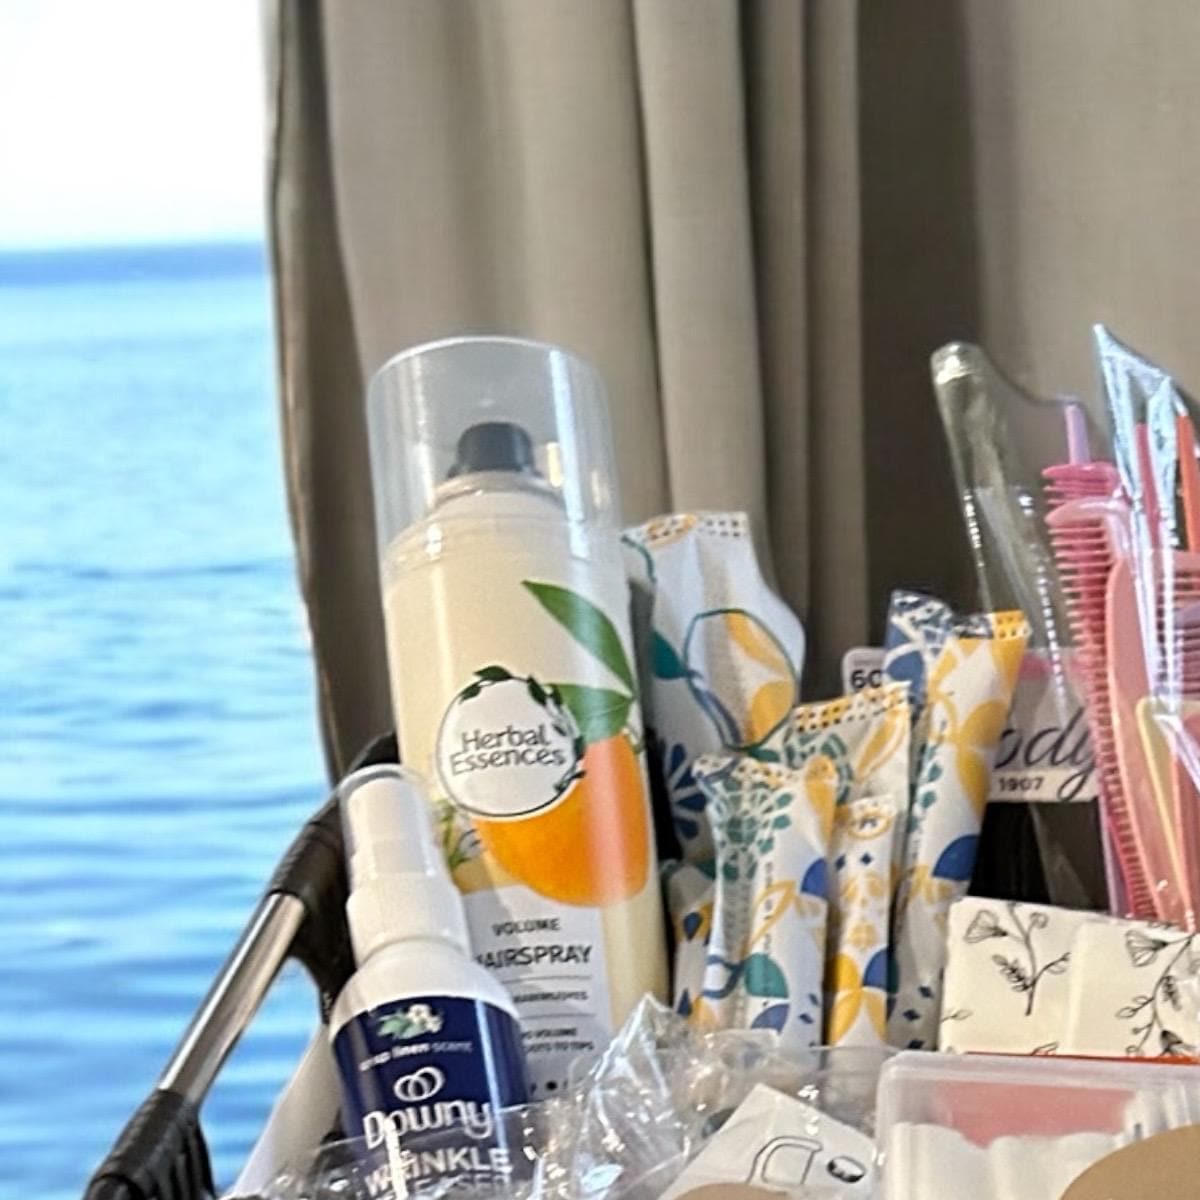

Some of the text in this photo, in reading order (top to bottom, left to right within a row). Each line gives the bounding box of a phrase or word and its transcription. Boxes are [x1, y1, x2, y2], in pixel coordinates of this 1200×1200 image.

[462, 724, 551, 753] Herbal
[449, 747, 566, 776] Essences
[492, 918, 561, 936] VOLUME
[363, 1099, 494, 1150] Downy
